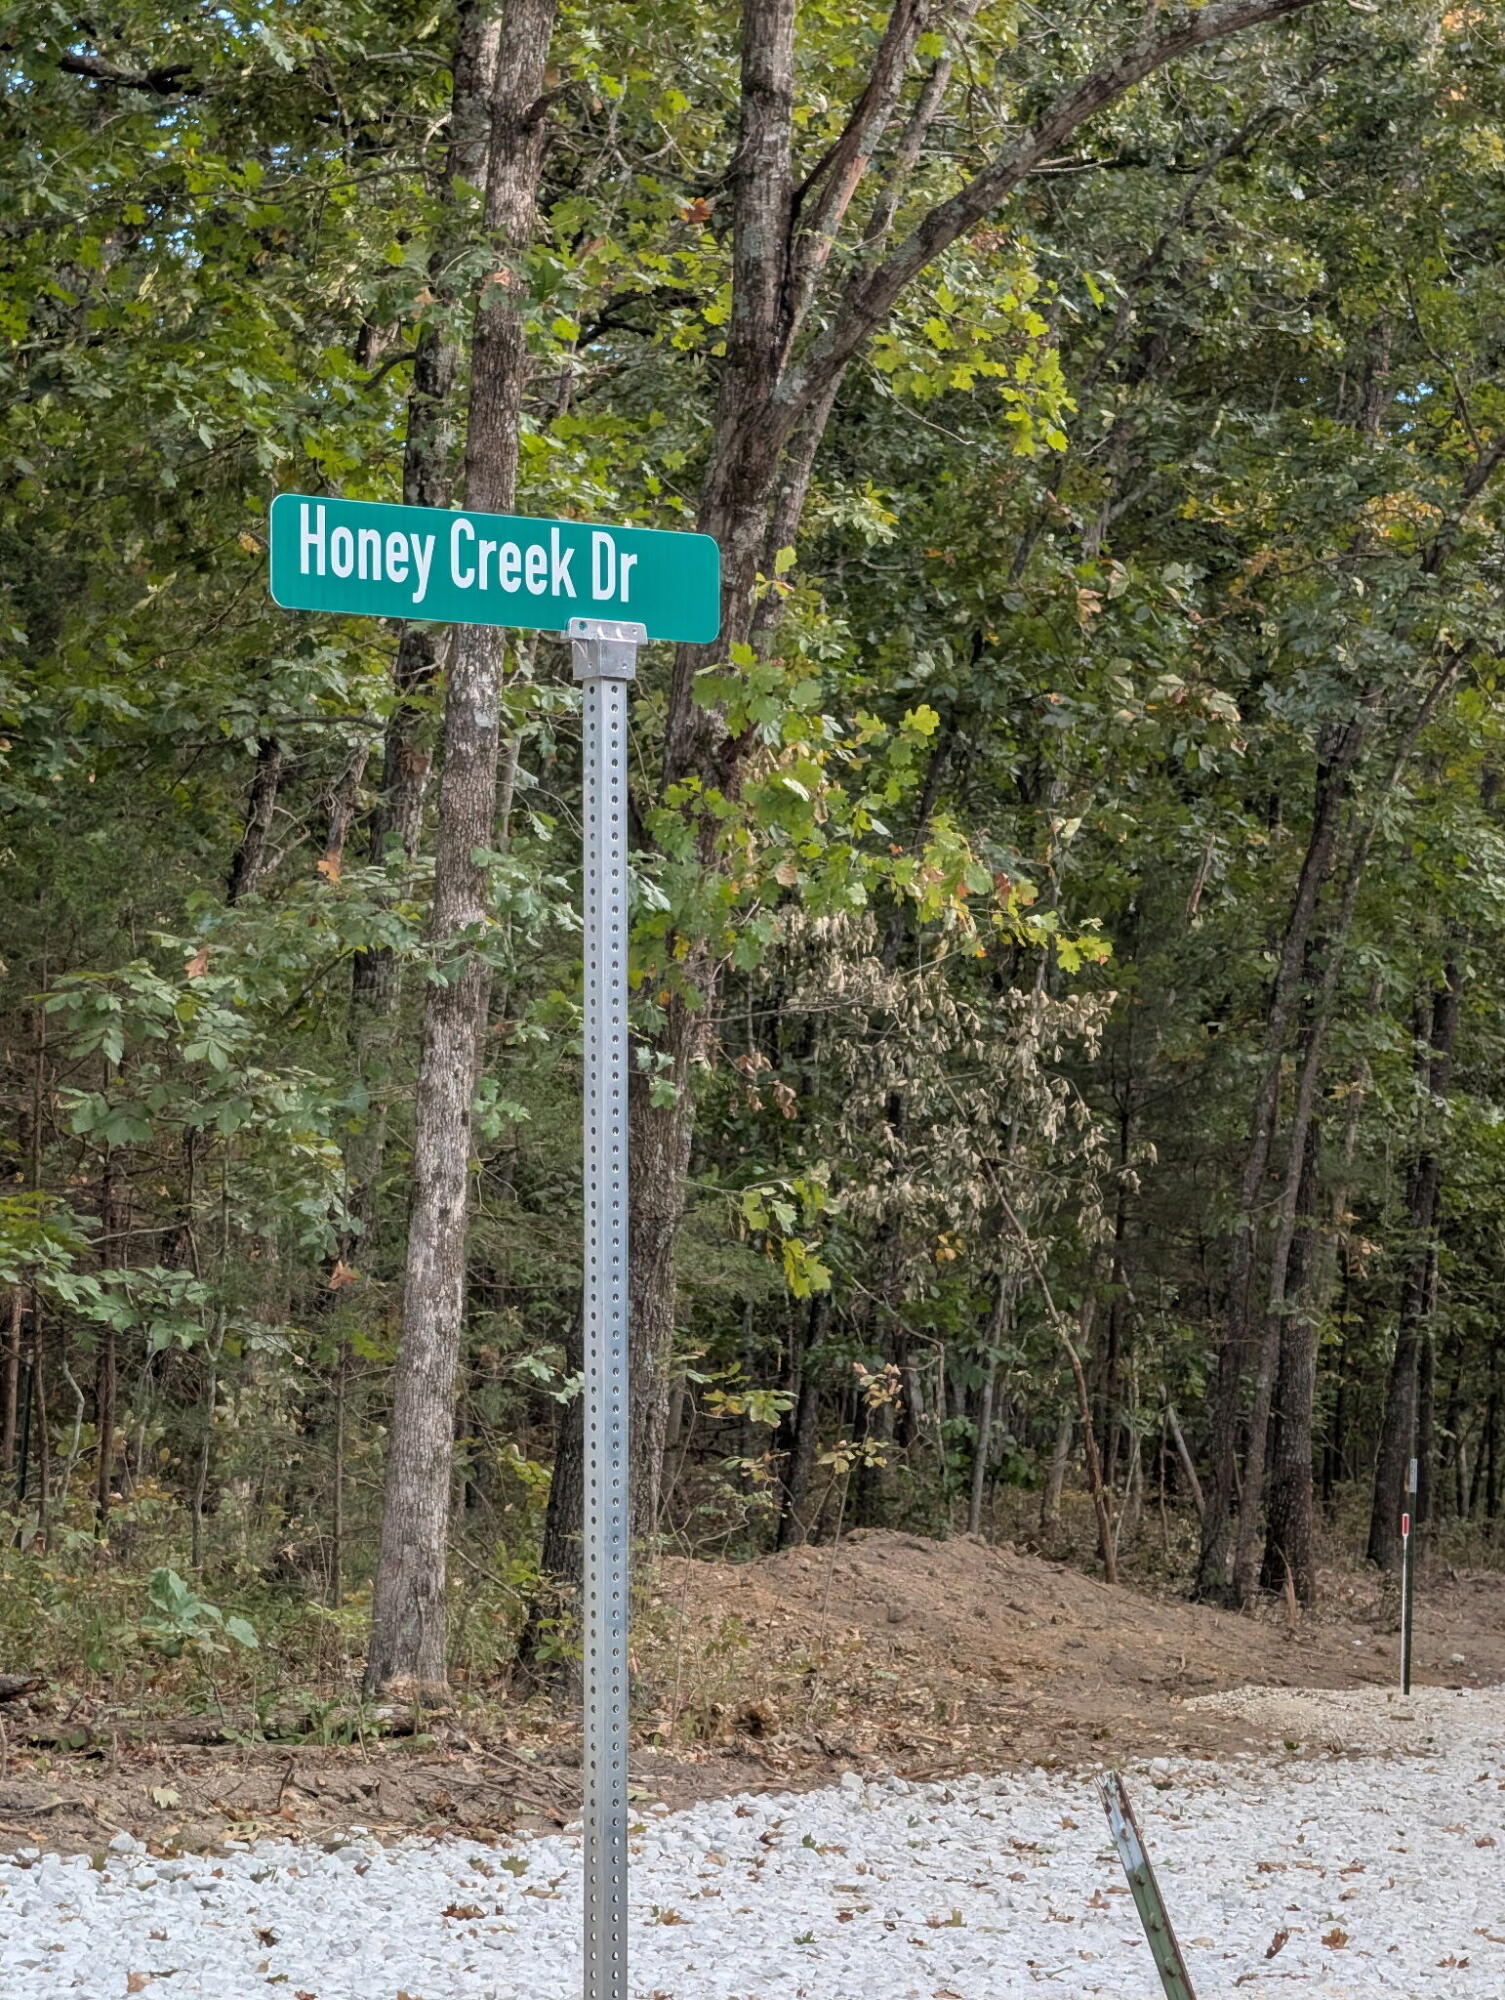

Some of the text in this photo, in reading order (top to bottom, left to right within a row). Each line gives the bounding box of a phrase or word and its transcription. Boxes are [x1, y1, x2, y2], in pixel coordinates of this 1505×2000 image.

[299, 503, 638, 603] Honey Creek Dr
